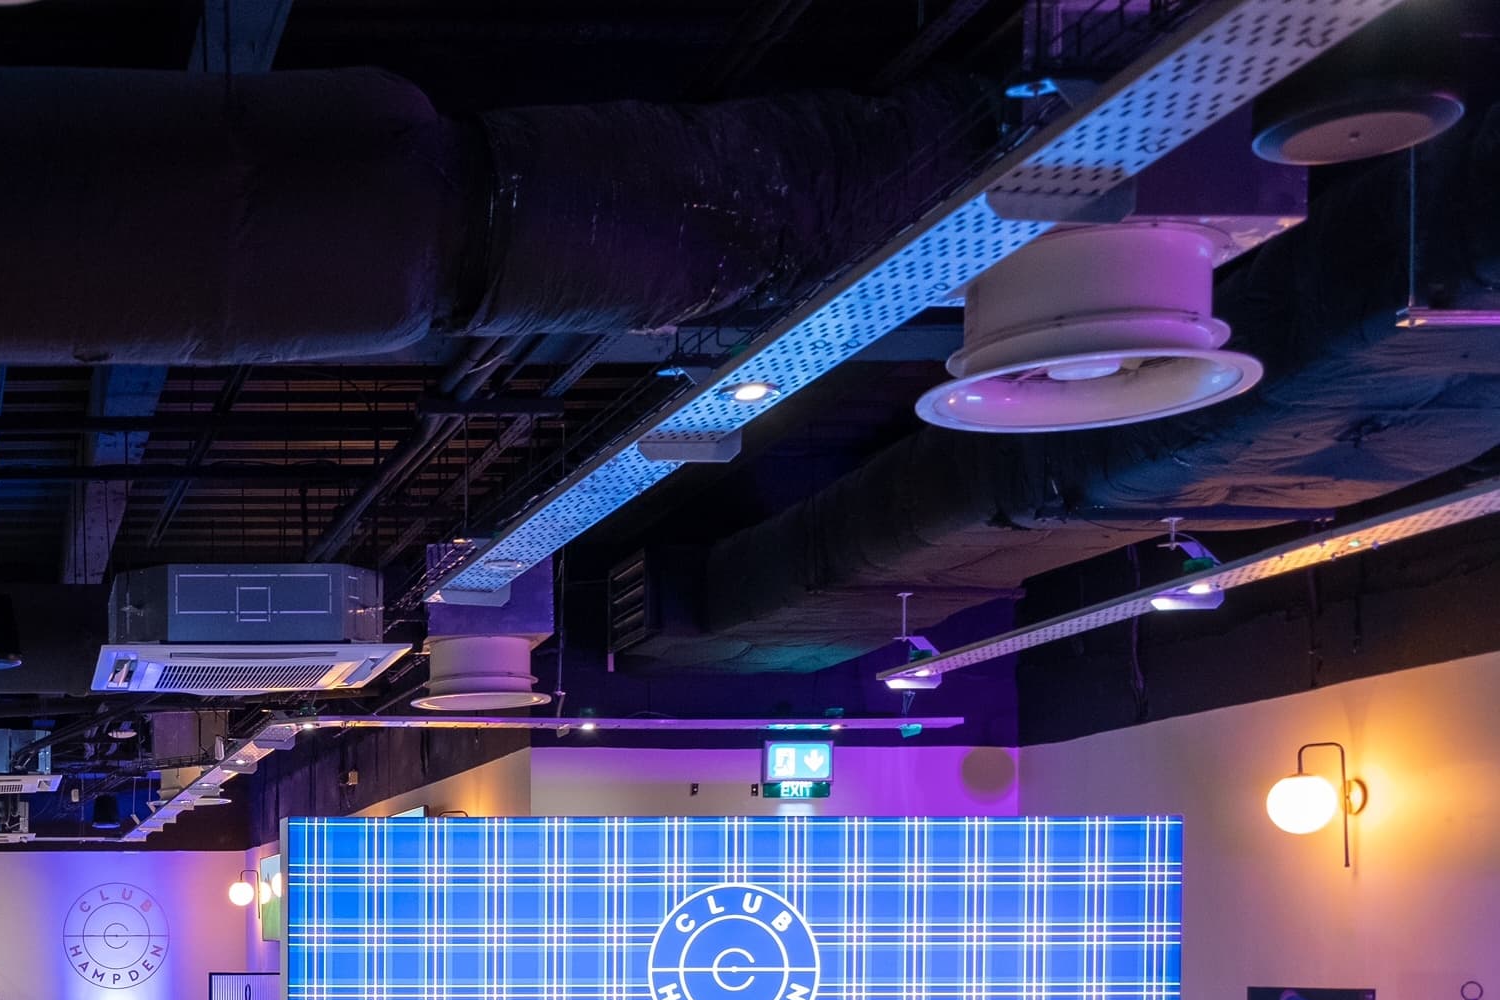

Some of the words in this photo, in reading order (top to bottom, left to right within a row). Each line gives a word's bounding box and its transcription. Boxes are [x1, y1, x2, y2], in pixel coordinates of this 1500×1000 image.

[780, 781, 813, 797] EXIT
[79, 888, 153, 913] CLUB
[675, 892, 793, 933] CLUB
[69, 944, 165, 985] HAMPDEN
